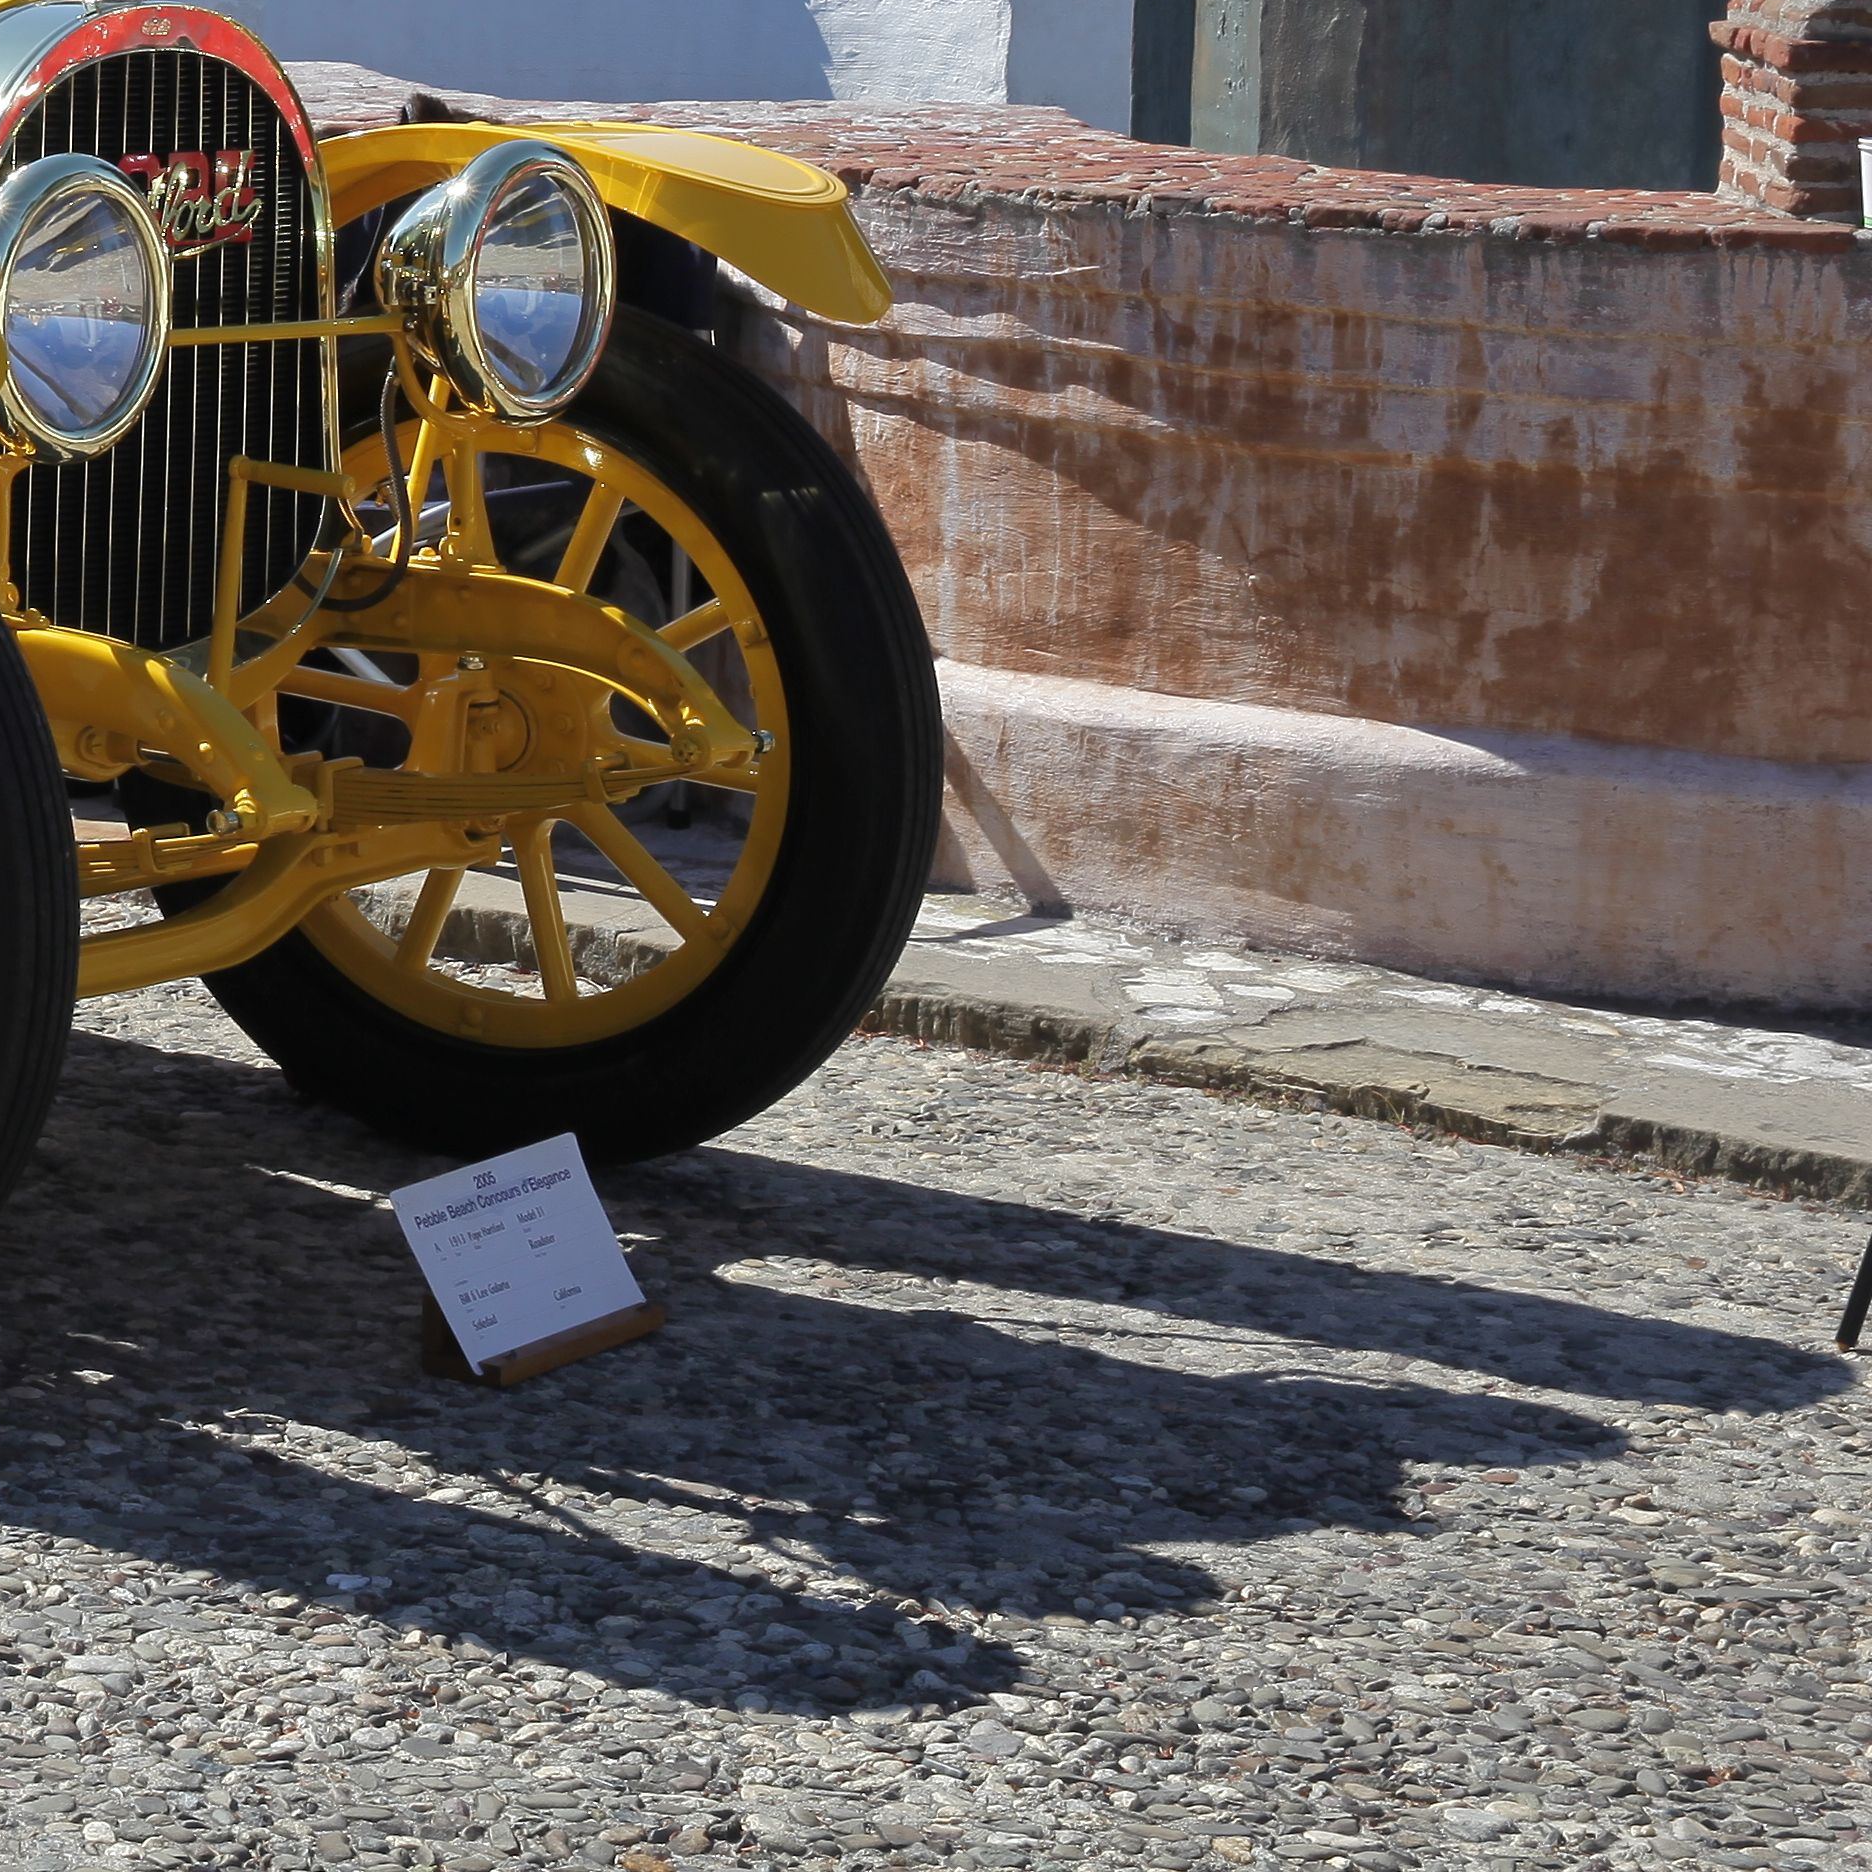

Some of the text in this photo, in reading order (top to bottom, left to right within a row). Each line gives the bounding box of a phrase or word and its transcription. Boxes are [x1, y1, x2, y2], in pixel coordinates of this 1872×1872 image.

[472, 1171, 497, 1190] 2005
[414, 1205, 449, 1230] Pebble
[446, 1198, 478, 1219] Beach
[476, 1185, 522, 1210] Concours
[516, 1209, 536, 1224] Model
[528, 1235, 555, 1249] Roadster
[553, 1286, 582, 1300] California
